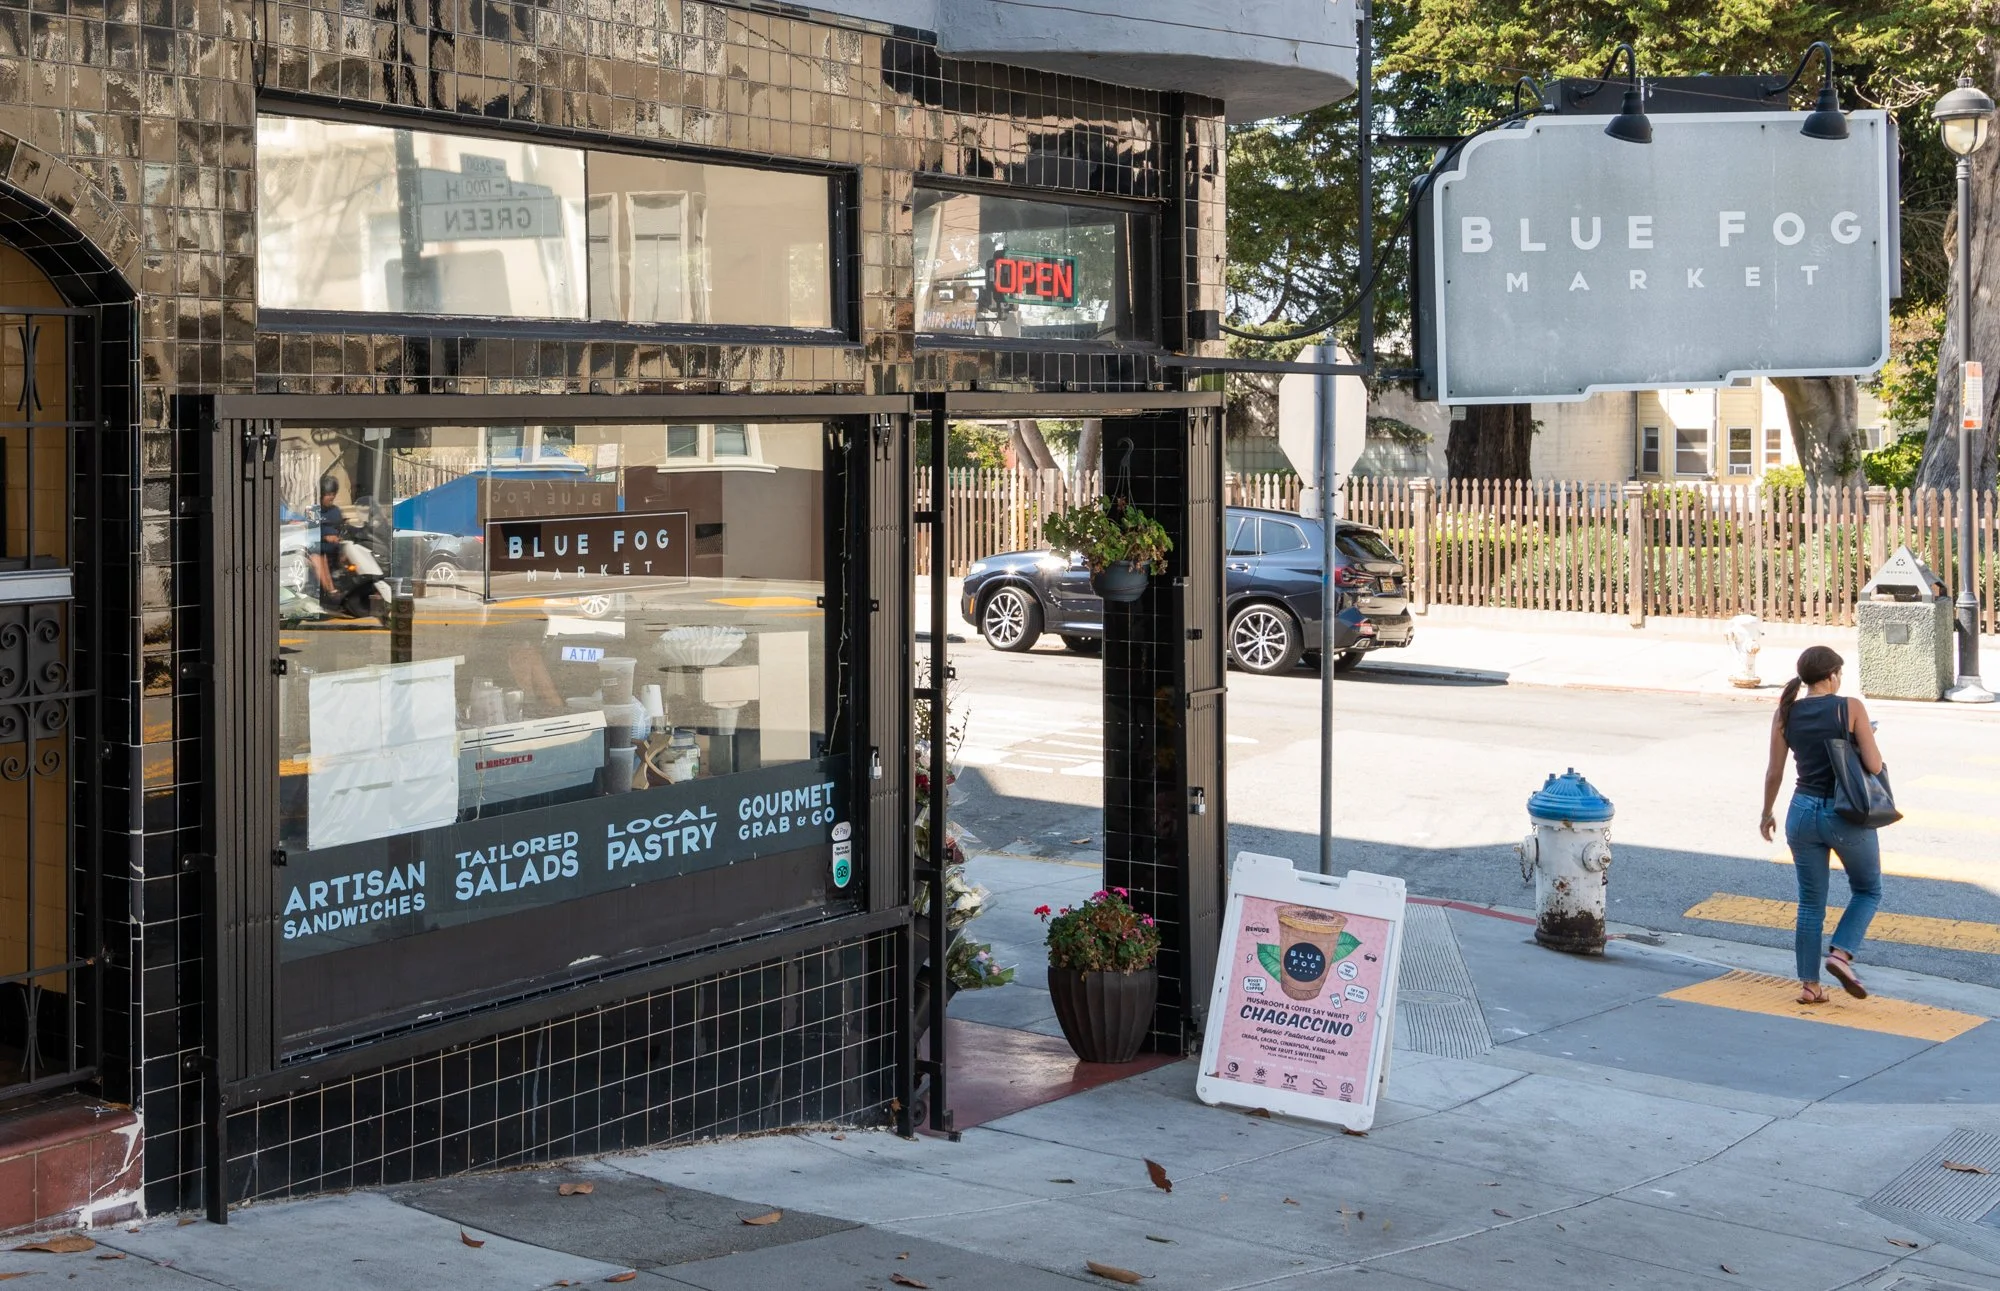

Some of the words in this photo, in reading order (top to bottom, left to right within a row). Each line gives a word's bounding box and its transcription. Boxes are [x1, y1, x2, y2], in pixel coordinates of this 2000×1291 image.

[1461, 215, 1654, 253] BLUE
[1719, 210, 1862, 247] FOG
[995, 258, 1073, 298] OPEN
[1506, 264, 1819, 293] MARKET
[922, 310, 945, 328] CHIPS
[951, 313, 976, 331] SALSA
[509, 534, 589, 559] BLUE
[613, 529, 669, 552] FOG
[527, 561, 653, 583] MARKET
[569, 648, 597, 660] ATM
[739, 781, 835, 821] GOURMET
[607, 805, 717, 838] LOCAL
[738, 816, 791, 840] GRAB
[796, 816, 807, 826] &
[811, 806, 835, 826] GO
[455, 831, 579, 869] TAILORED
[607, 822, 717, 871] PASTRY
[283, 860, 426, 916] ARTISAN
[455, 850, 579, 901] SALADS
[283, 892, 426, 940] SANDWICHES
[1290, 950, 1321, 961] BLUE
[1292, 959, 1316, 969] FOG
[1240, 1004, 1354, 1037] CHAGACCINO
[1246, 996, 1284, 1009] MUSHROOM
[1291, 1005, 1311, 1014] COFFEE
[1312, 1008, 1325, 1016] SAY
[1326, 1010, 1350, 1020] WHAT?
[1241, 1033, 1259, 1042] CHAGA,
[1260, 1036, 1279, 1045] CACAO,
[1280, 1038, 1311, 1051] CINNAMON,
[1312, 1045, 1336, 1056] VANILLA,
[1337, 1049, 1349, 1057] AND
[1256, 1026, 1283, 1037] organic
[1283, 1030, 1315, 1042] Featured
[1316, 1036, 1337, 1045] Drink
[1260, 1044, 1277, 1052] MONK
[1278, 1047, 1293, 1055] FRUIT
[1294, 1050, 1326, 1061] SWEETENER
